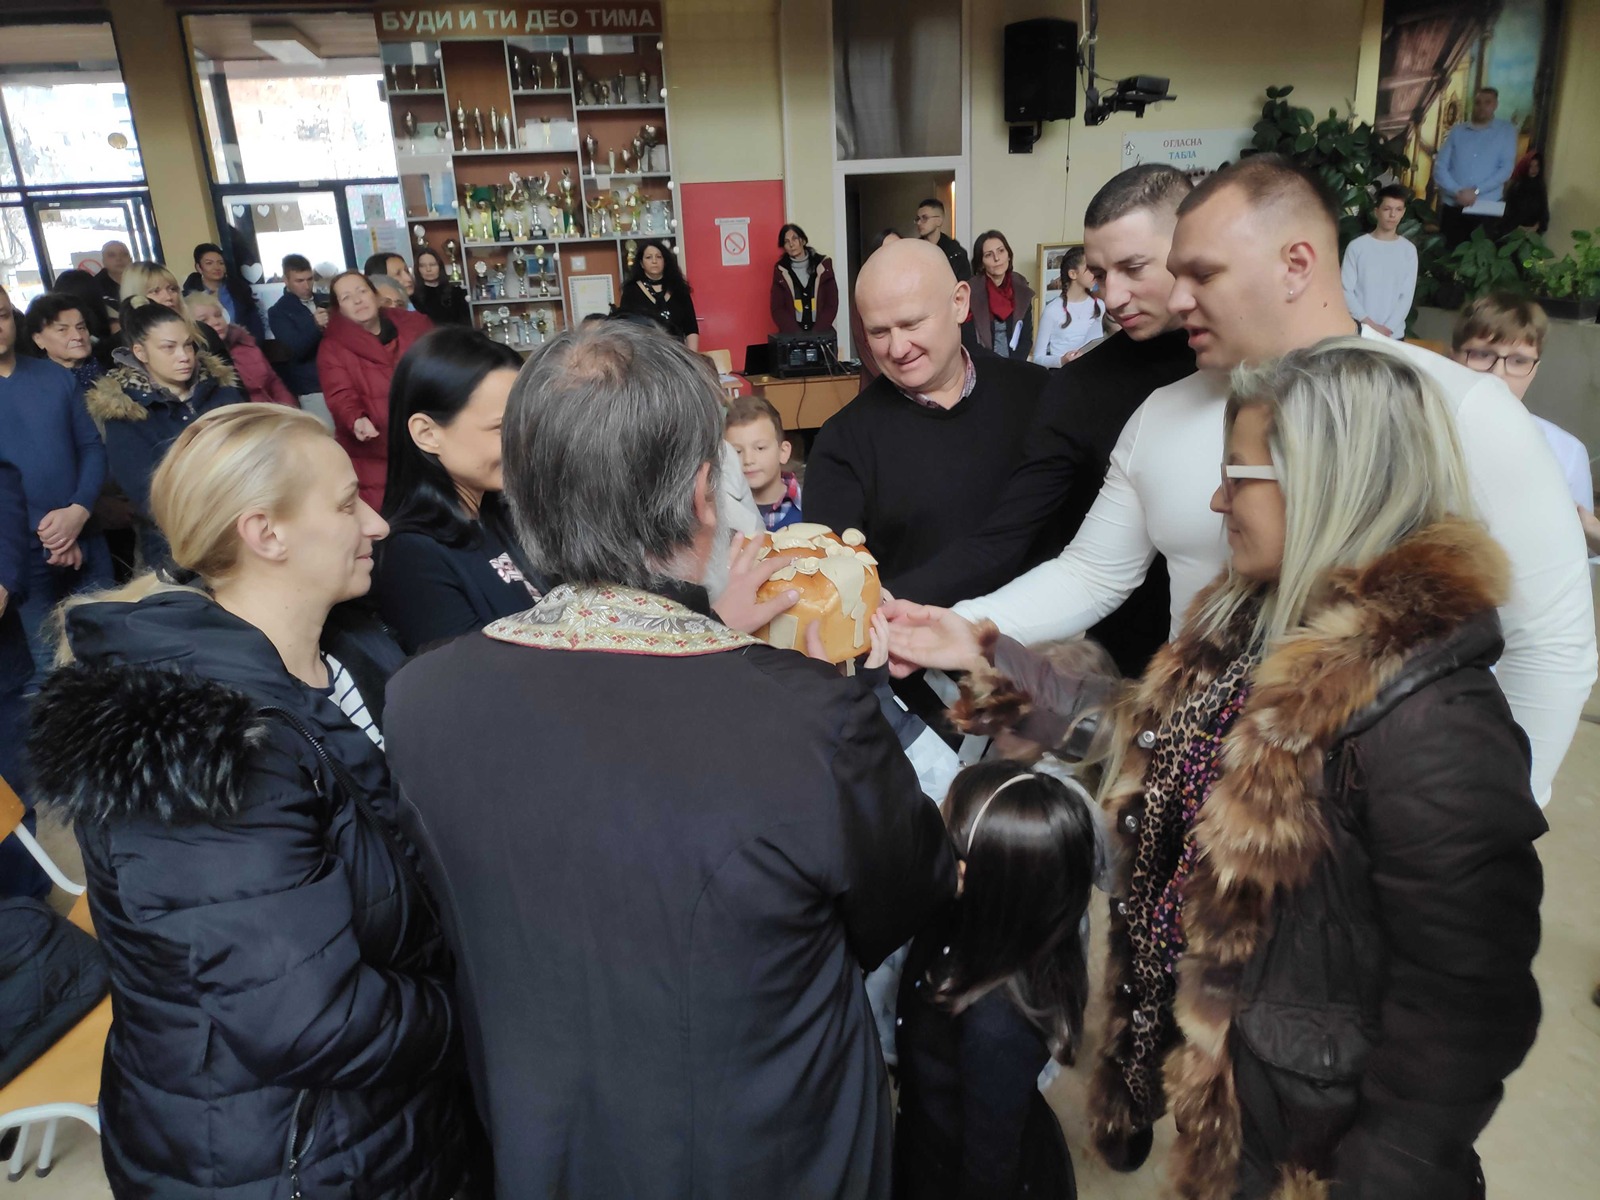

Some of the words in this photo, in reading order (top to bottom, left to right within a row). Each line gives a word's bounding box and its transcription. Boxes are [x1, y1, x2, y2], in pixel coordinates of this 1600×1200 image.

[382, 11, 453, 34] БУДИ
[459, 11, 476, 29] И
[483, 10, 517, 29] ТИ
[525, 9, 578, 32] ДЕО
[585, 9, 655, 27] ТИМА
[1163, 138, 1202, 148] ОГЛАСНА
[1169, 150, 1197, 160] ТАБЛА
